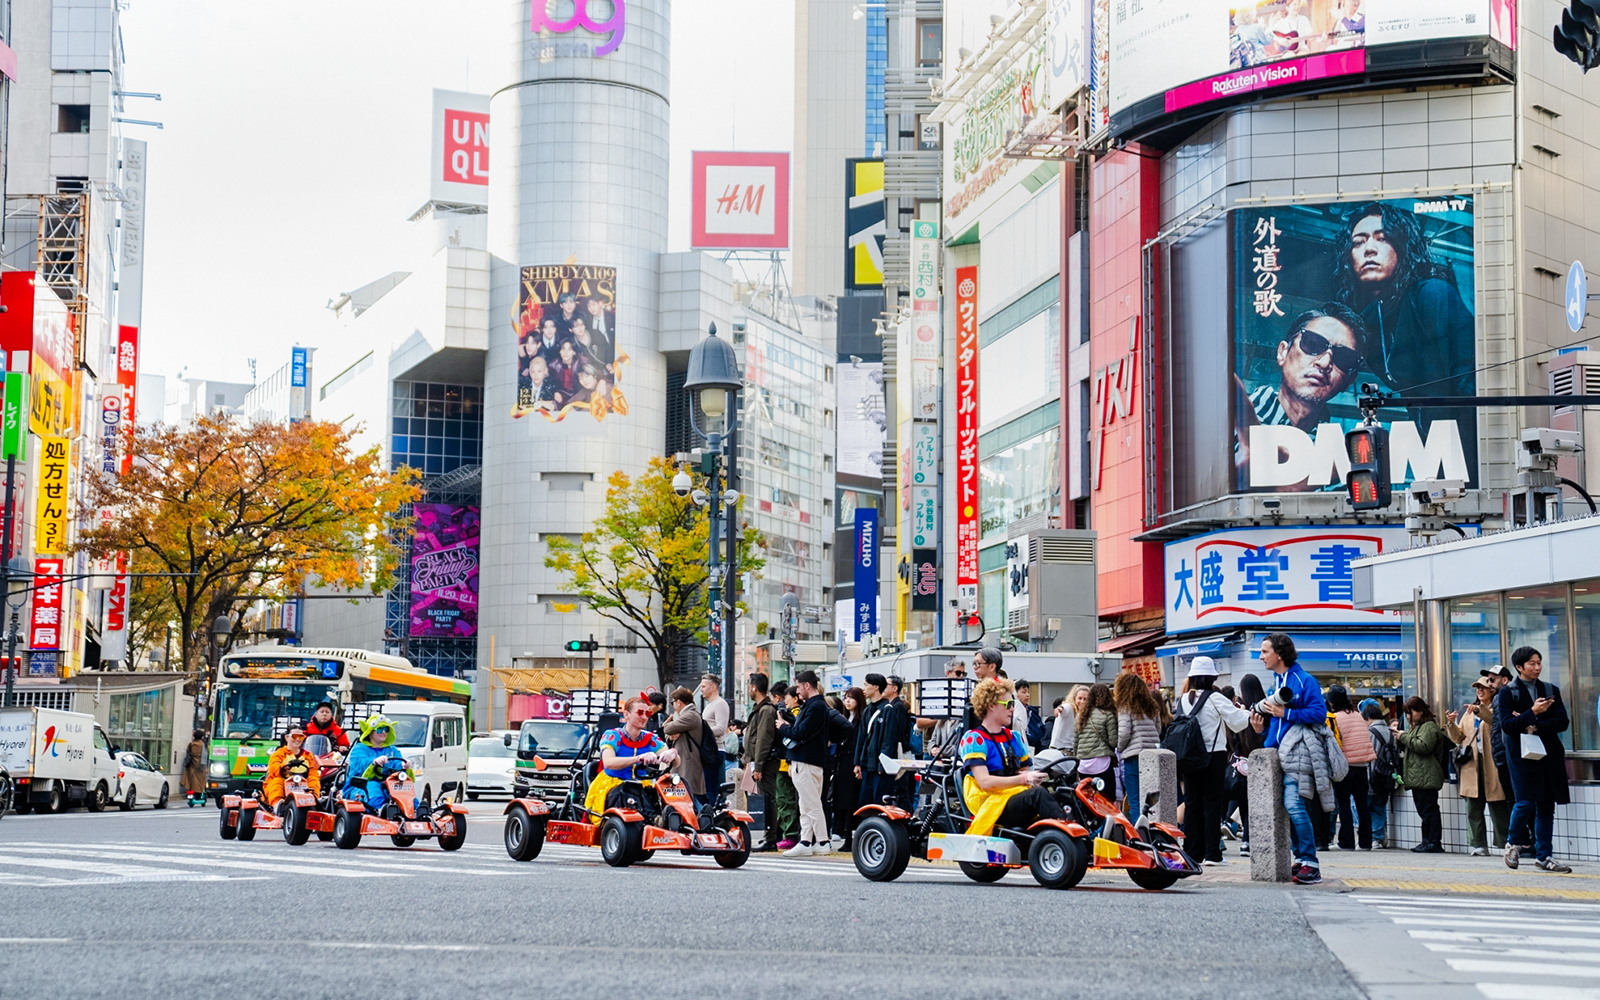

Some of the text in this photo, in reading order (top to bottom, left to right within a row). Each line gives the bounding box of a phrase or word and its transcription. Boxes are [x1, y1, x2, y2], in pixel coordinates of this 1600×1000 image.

[1211, 65, 1298, 95] Rakuten Vision
[123, 150, 142, 268] BIC CAMERA
[716, 183, 766, 216] H&M
[1413, 199, 1467, 214] DMM TV
[521, 265, 616, 281] SHIBUYA109
[1252, 216, 1286, 318] 外道の歌
[520, 278, 616, 307] XMAS
[119, 340, 135, 372] 免税
[6, 401, 17, 429] レイク
[102, 396, 121, 424] OS
[958, 299, 977, 503] ウィンターフルーツギフト
[926, 436, 935, 467] フルーツ
[43, 442, 66, 518] 処方せん
[915, 502, 925, 534] フルーツ
[426, 548, 466, 563] BLACK
[861, 520, 873, 568] MIZUHO
[420, 573, 457, 591] PARTY
[918, 562, 936, 595] HUB
[1174, 544, 1361, 613] 大盛堂書
[33, 562, 61, 646] スギ薬局
[860, 603, 870, 639] みずほ
[1177, 646, 1199, 655] TAISEIDO
[1344, 653, 1410, 661] TAISEIDO
[31, 662, 57, 674] 営業
[0, 738, 28, 751] Hyorei
[65, 745, 85, 761] Hyorei
[551, 825, 573, 833] JAPAN
